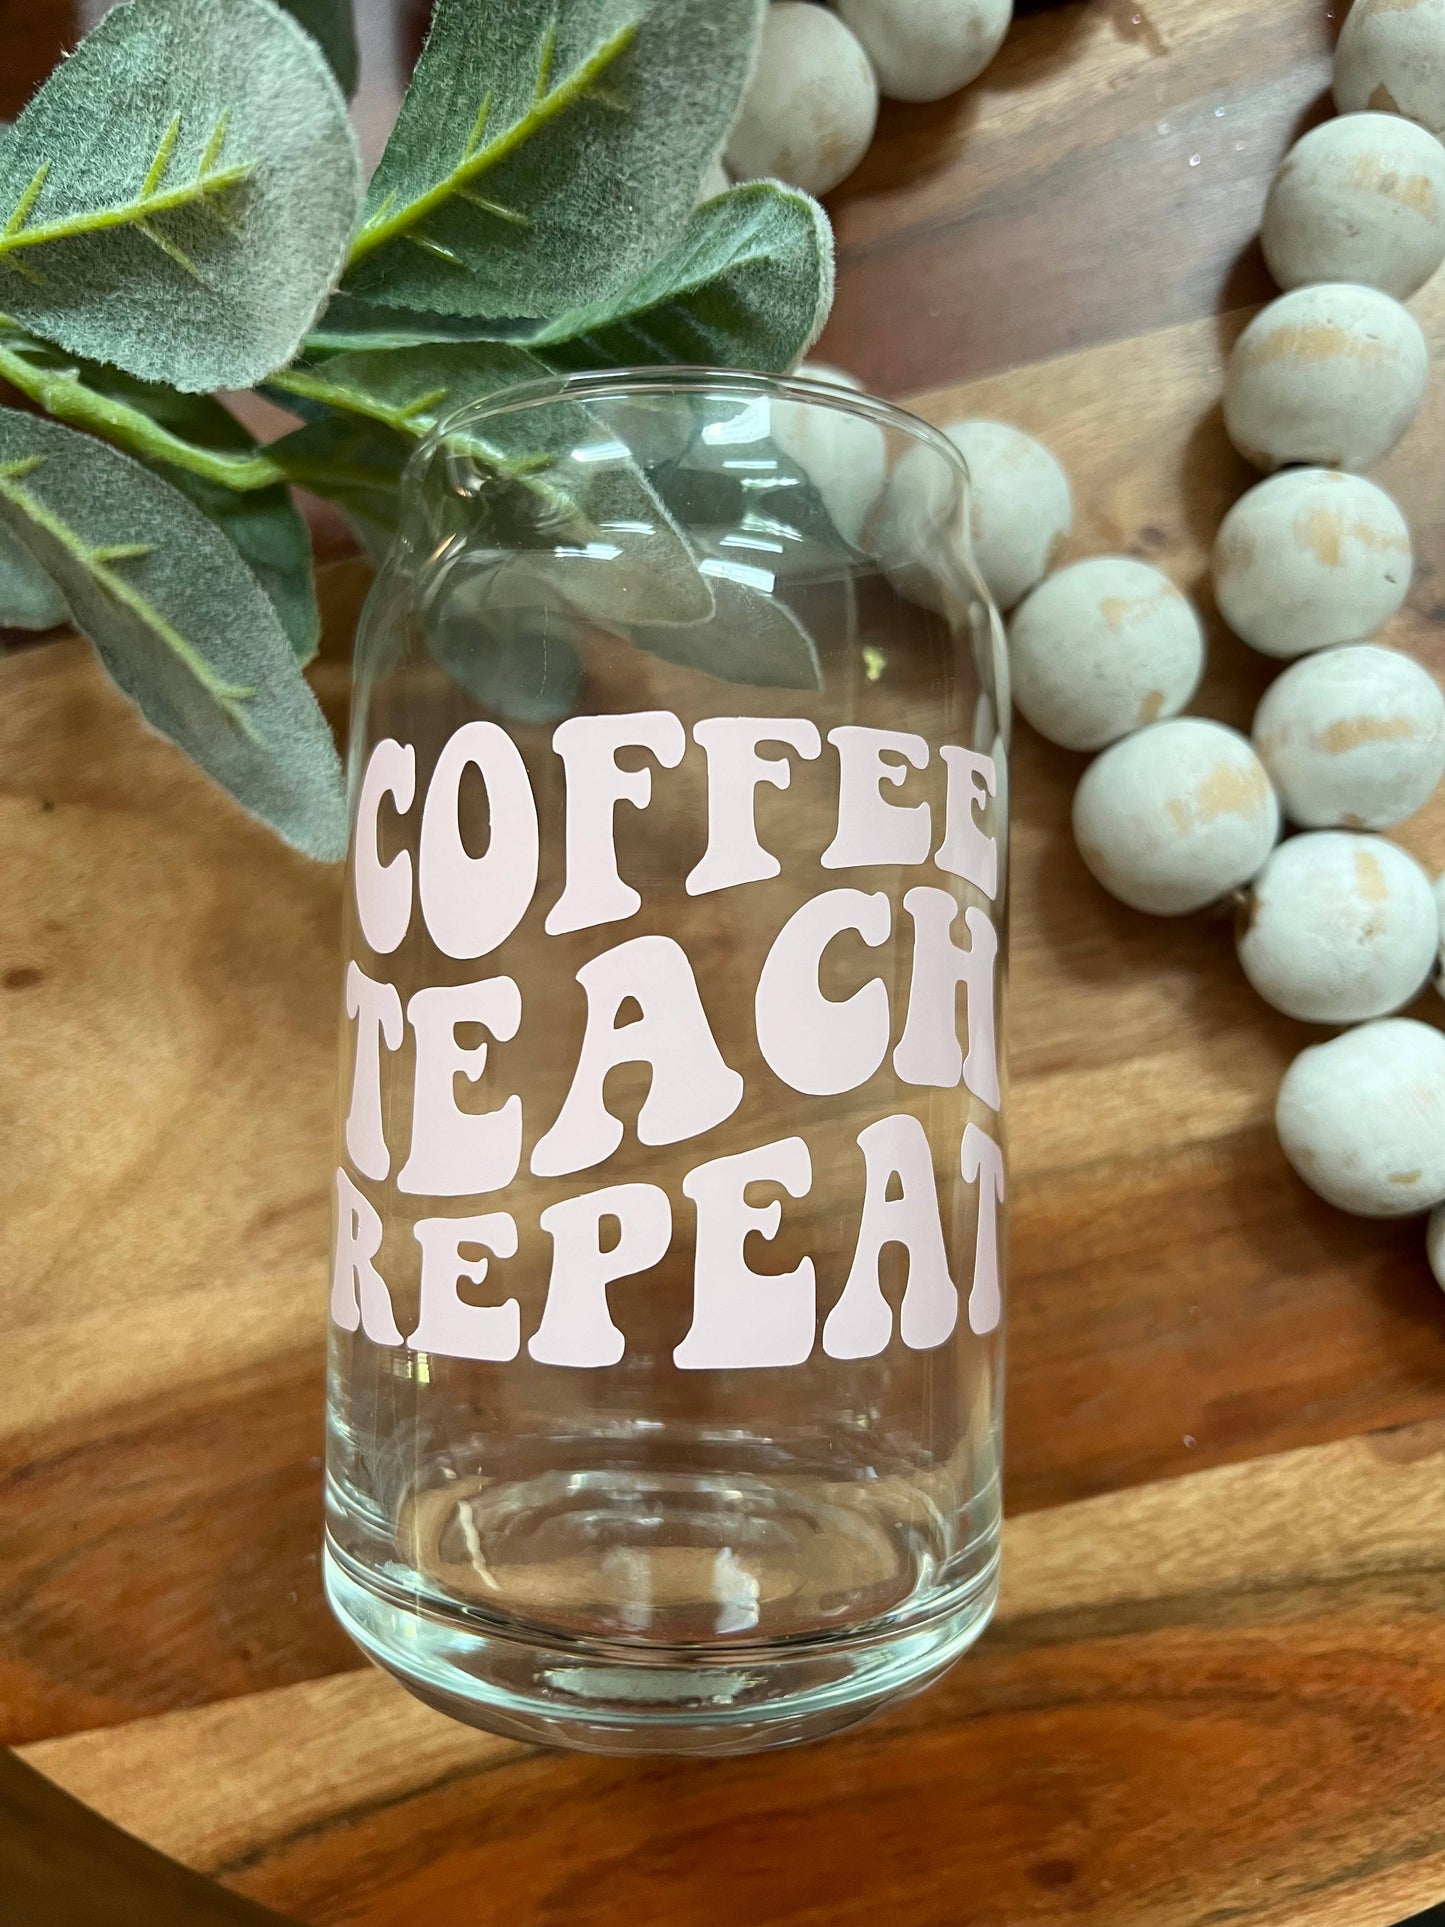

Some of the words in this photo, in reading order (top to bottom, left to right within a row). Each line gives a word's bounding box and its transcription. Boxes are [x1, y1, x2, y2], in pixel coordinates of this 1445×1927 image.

[354, 710, 998, 959] COFFEE
[345, 886, 1001, 1197] TEACH
[331, 1114, 1004, 1370] REPEAT
